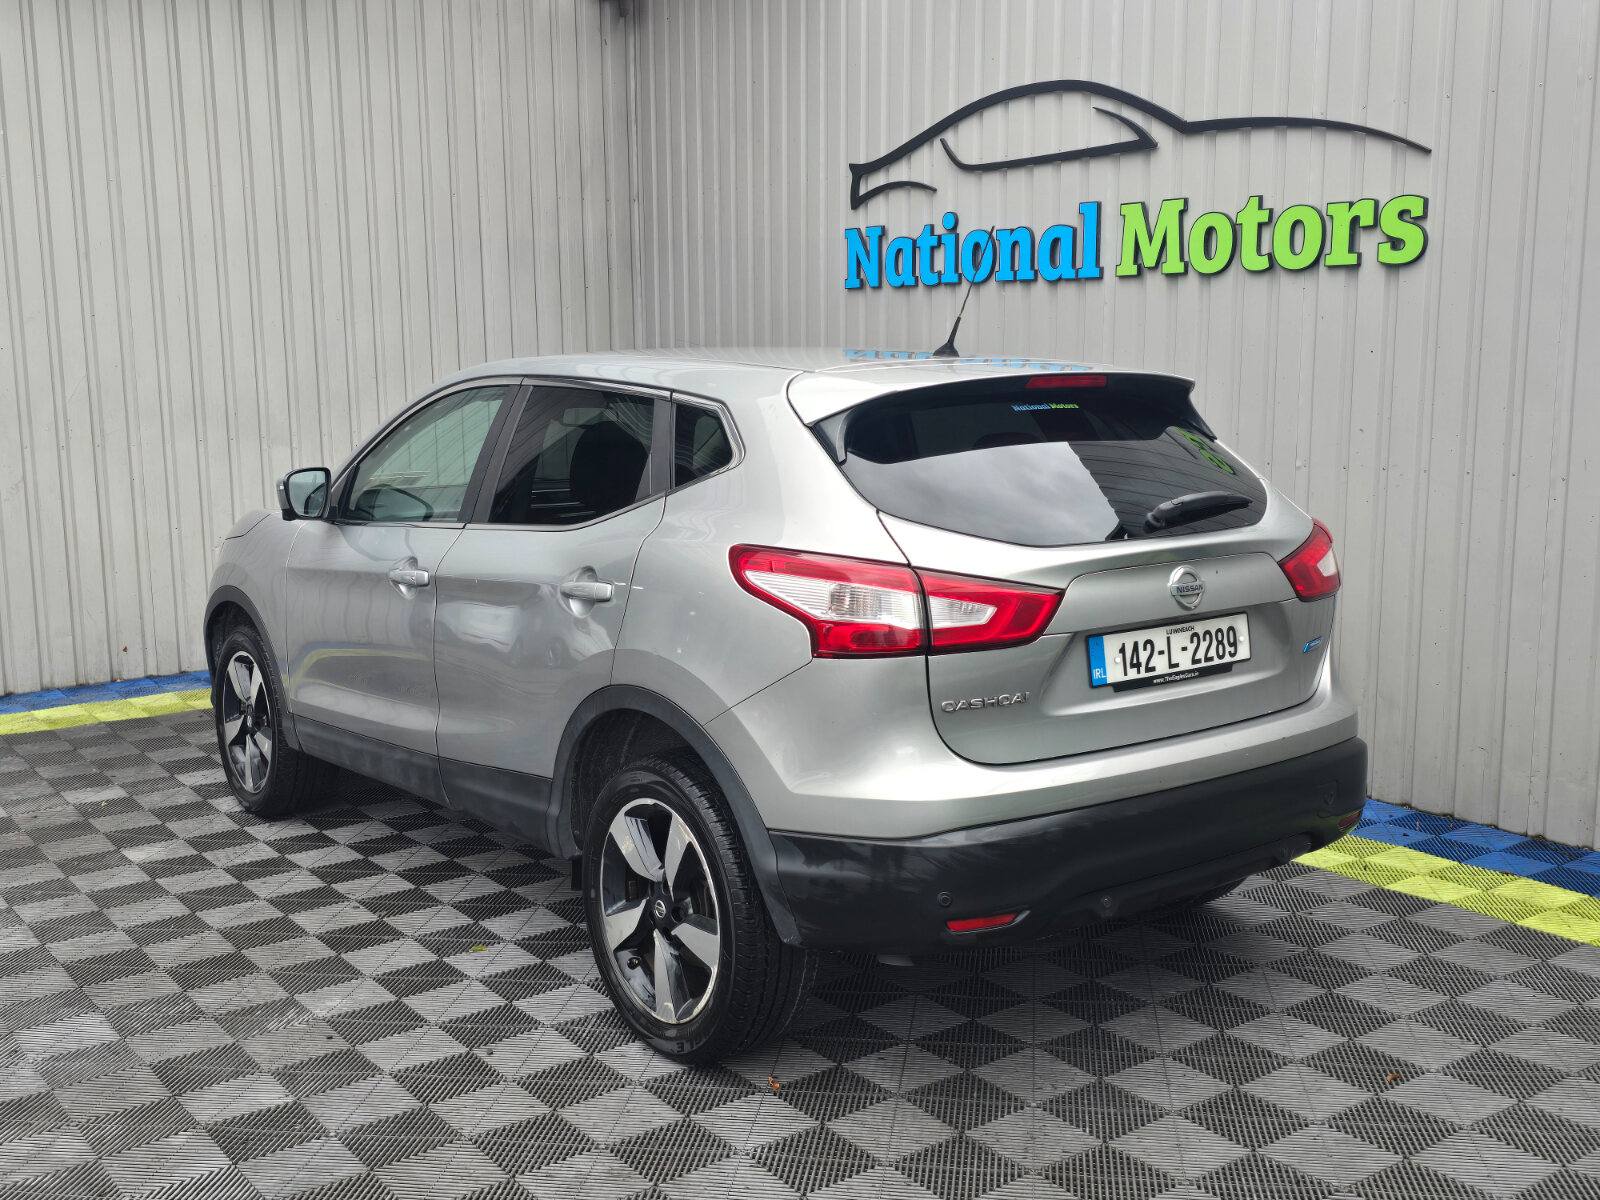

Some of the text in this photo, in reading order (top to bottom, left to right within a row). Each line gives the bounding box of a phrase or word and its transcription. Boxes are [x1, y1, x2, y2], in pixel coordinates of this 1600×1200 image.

[844, 194, 1430, 290] National Motors
[1176, 584, 1203, 593] NISSAN
[1118, 625, 1238, 677] 142-L-2289
[1093, 668, 1107, 679] IRL
[941, 691, 1030, 712] QASHQAI
